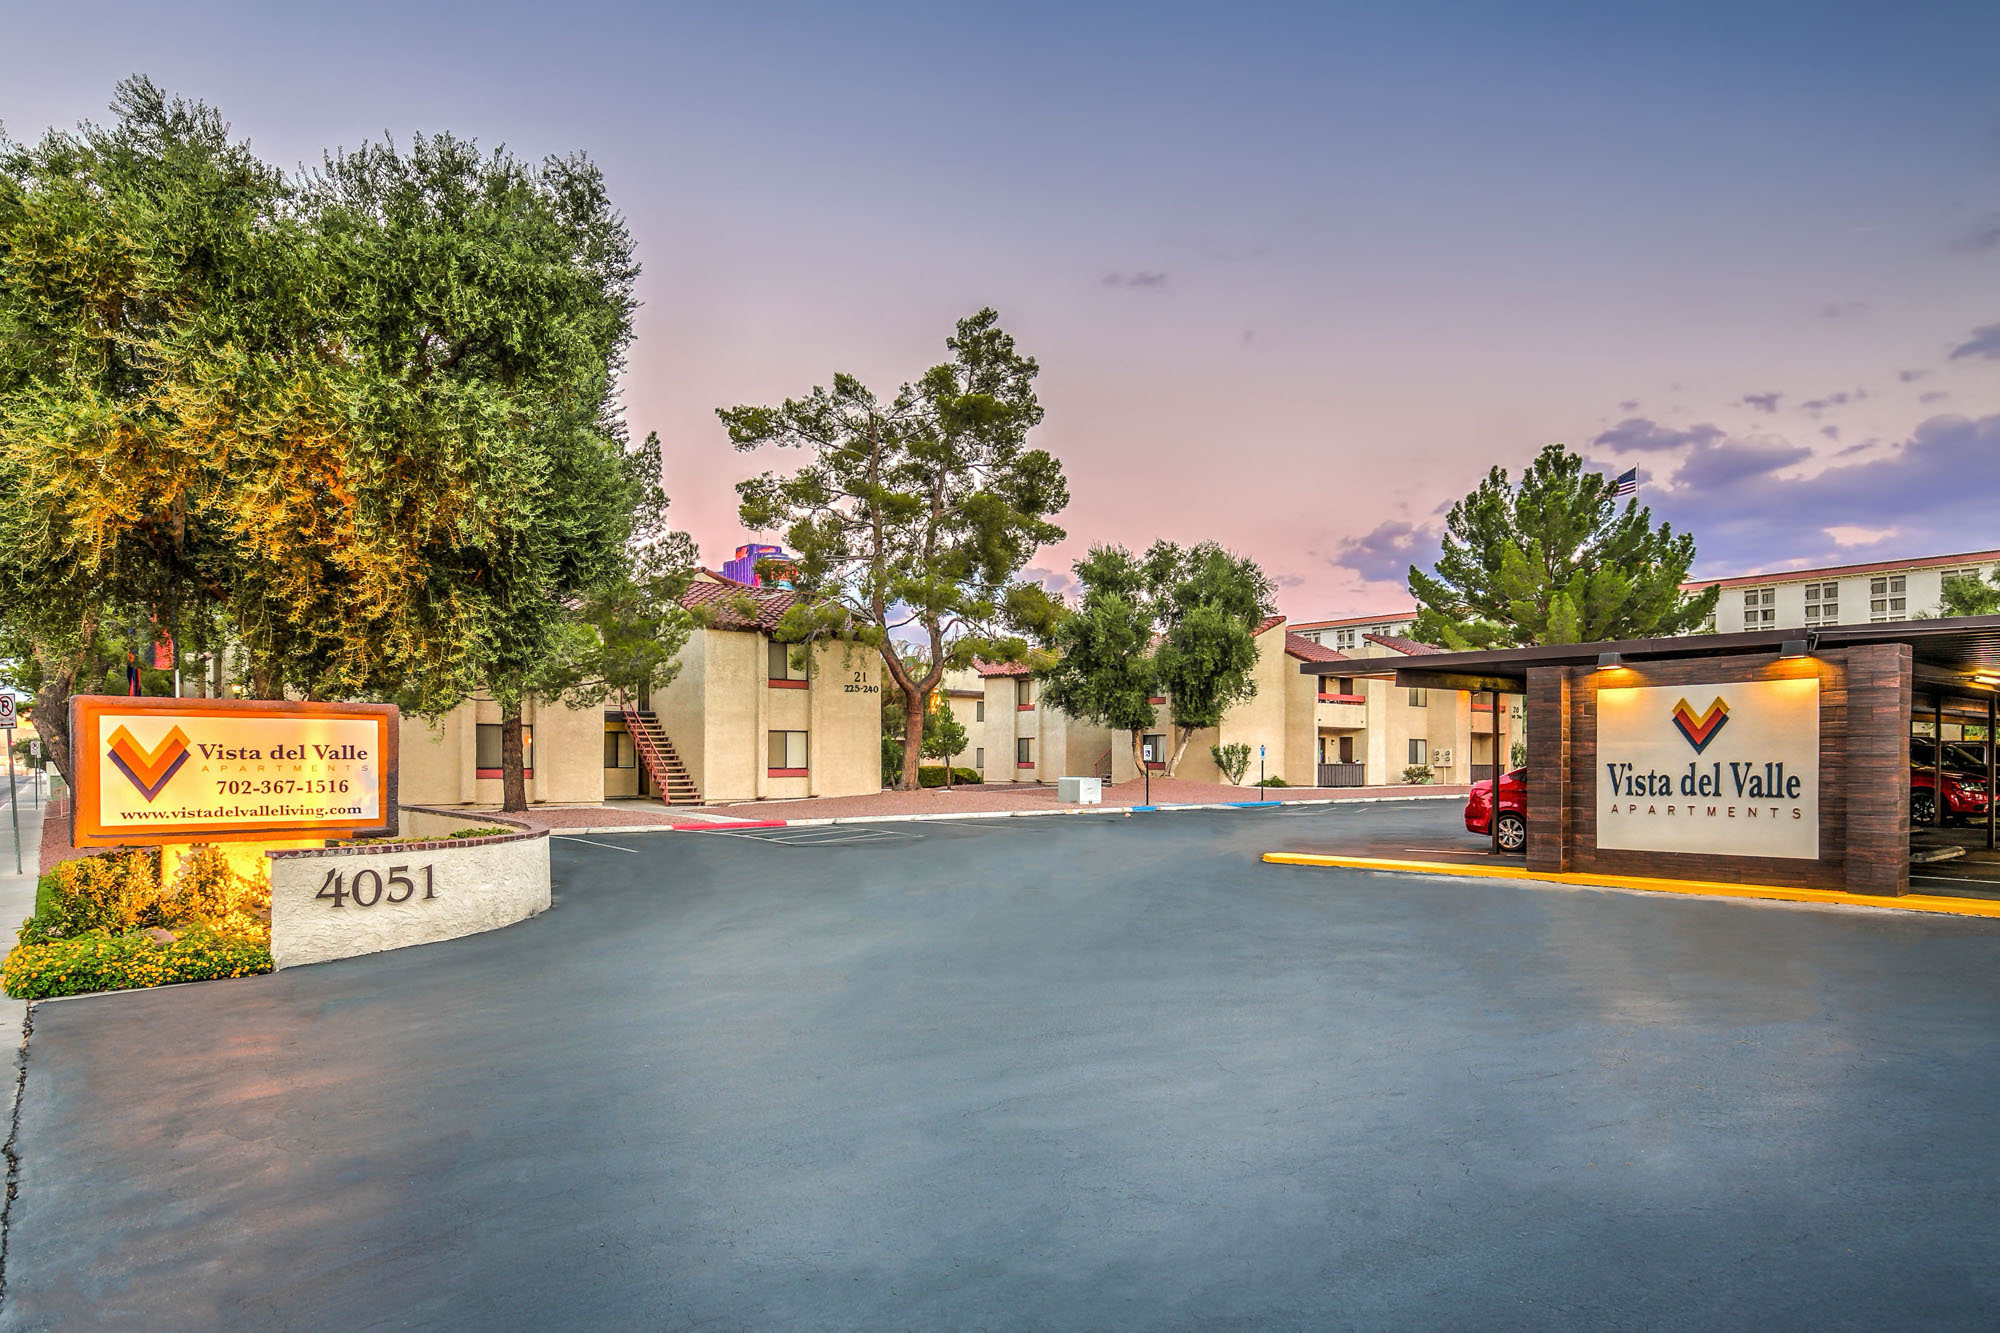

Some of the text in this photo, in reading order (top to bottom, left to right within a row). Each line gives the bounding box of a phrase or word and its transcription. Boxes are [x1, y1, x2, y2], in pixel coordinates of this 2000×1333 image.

[854, 671, 867, 683] 21
[844, 684, 879, 693] 225-240
[197, 743, 368, 760] Vista del Valle
[201, 764, 369, 773] APARTMENTS
[216, 779, 349, 795] 702-367-1516
[1606, 761, 1801, 799] Vista del Valle
[120, 804, 363, 820] www.vistadelvalleliving.com
[1611, 803, 1802, 820] APARTMENTS
[315, 864, 440, 908] 4051
